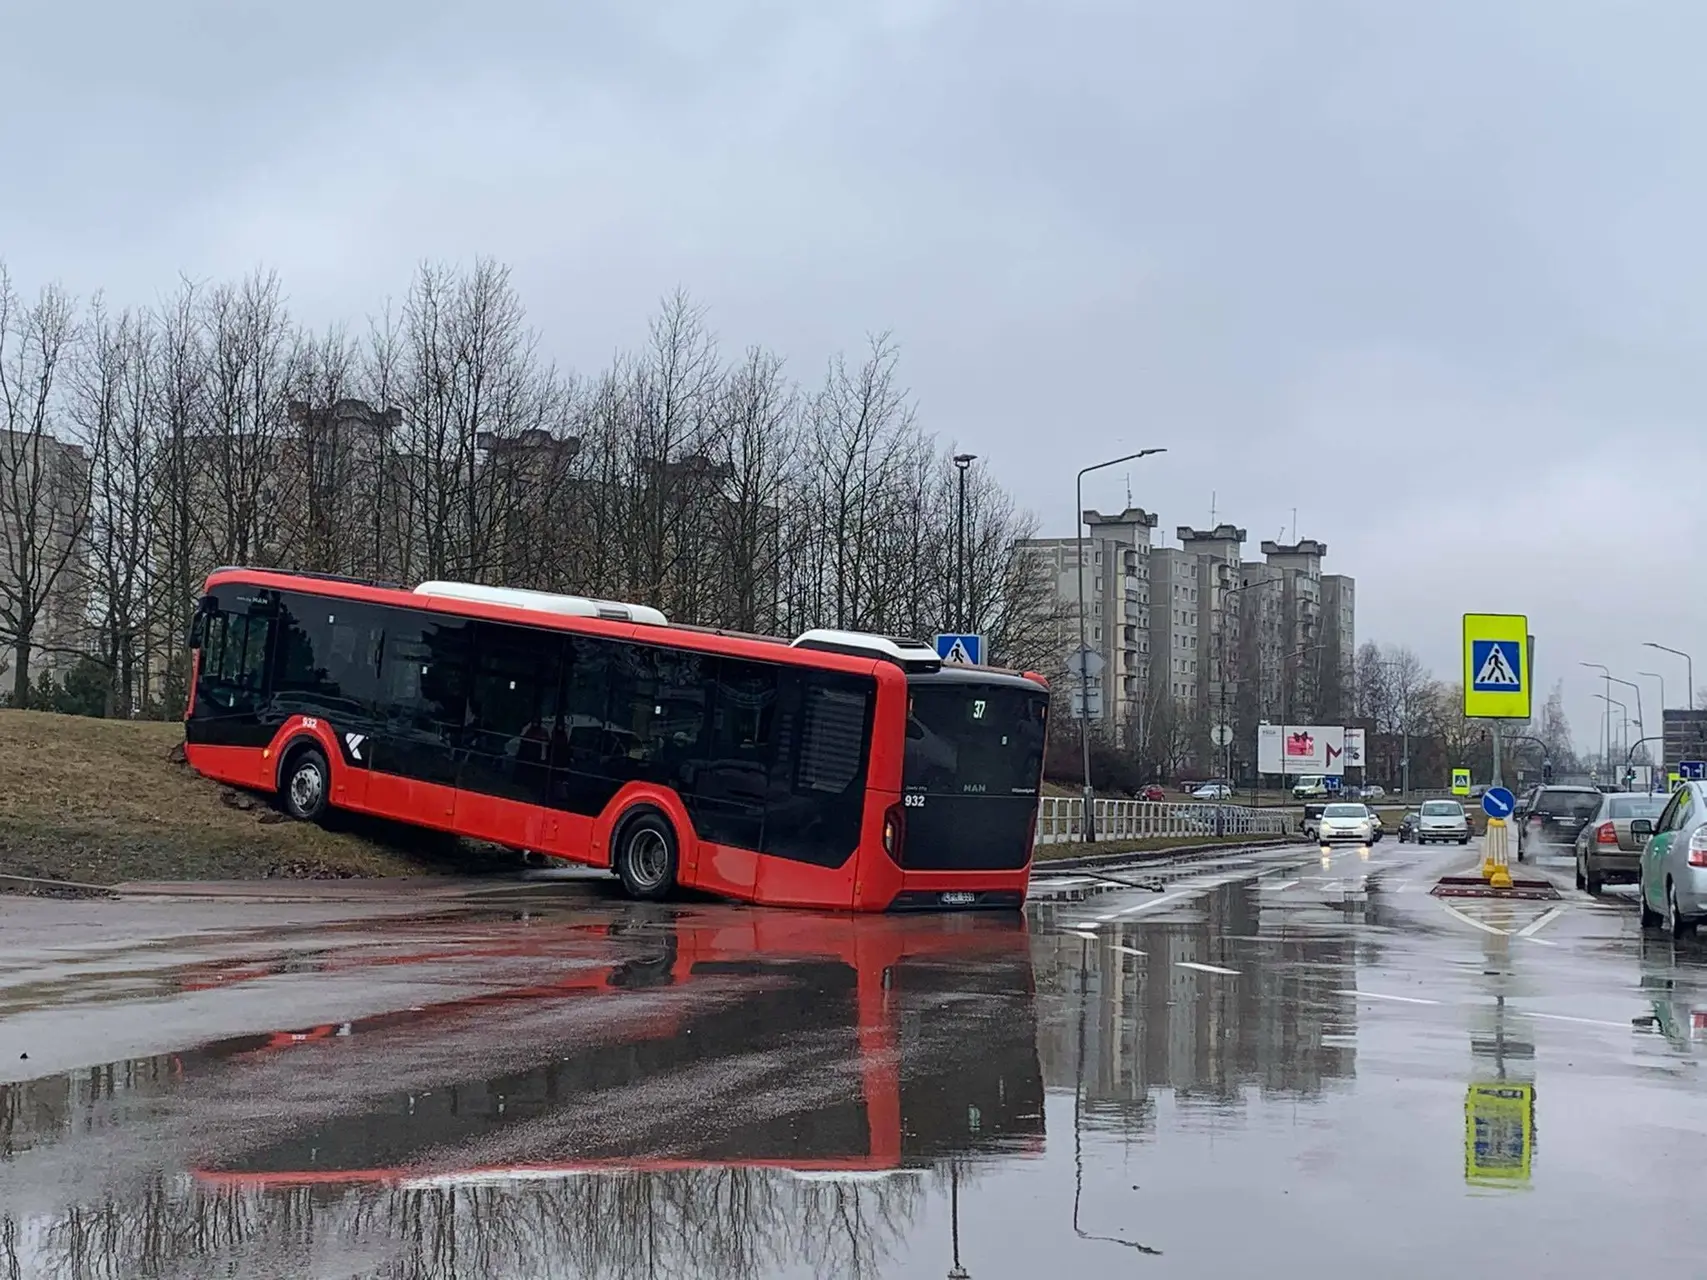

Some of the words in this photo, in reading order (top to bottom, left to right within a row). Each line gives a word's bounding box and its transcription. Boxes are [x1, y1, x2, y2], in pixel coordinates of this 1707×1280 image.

[973, 700, 986, 718] 37
[302, 717, 317, 729] 932
[963, 784, 986, 792] MAN
[904, 795, 925, 807] 932
